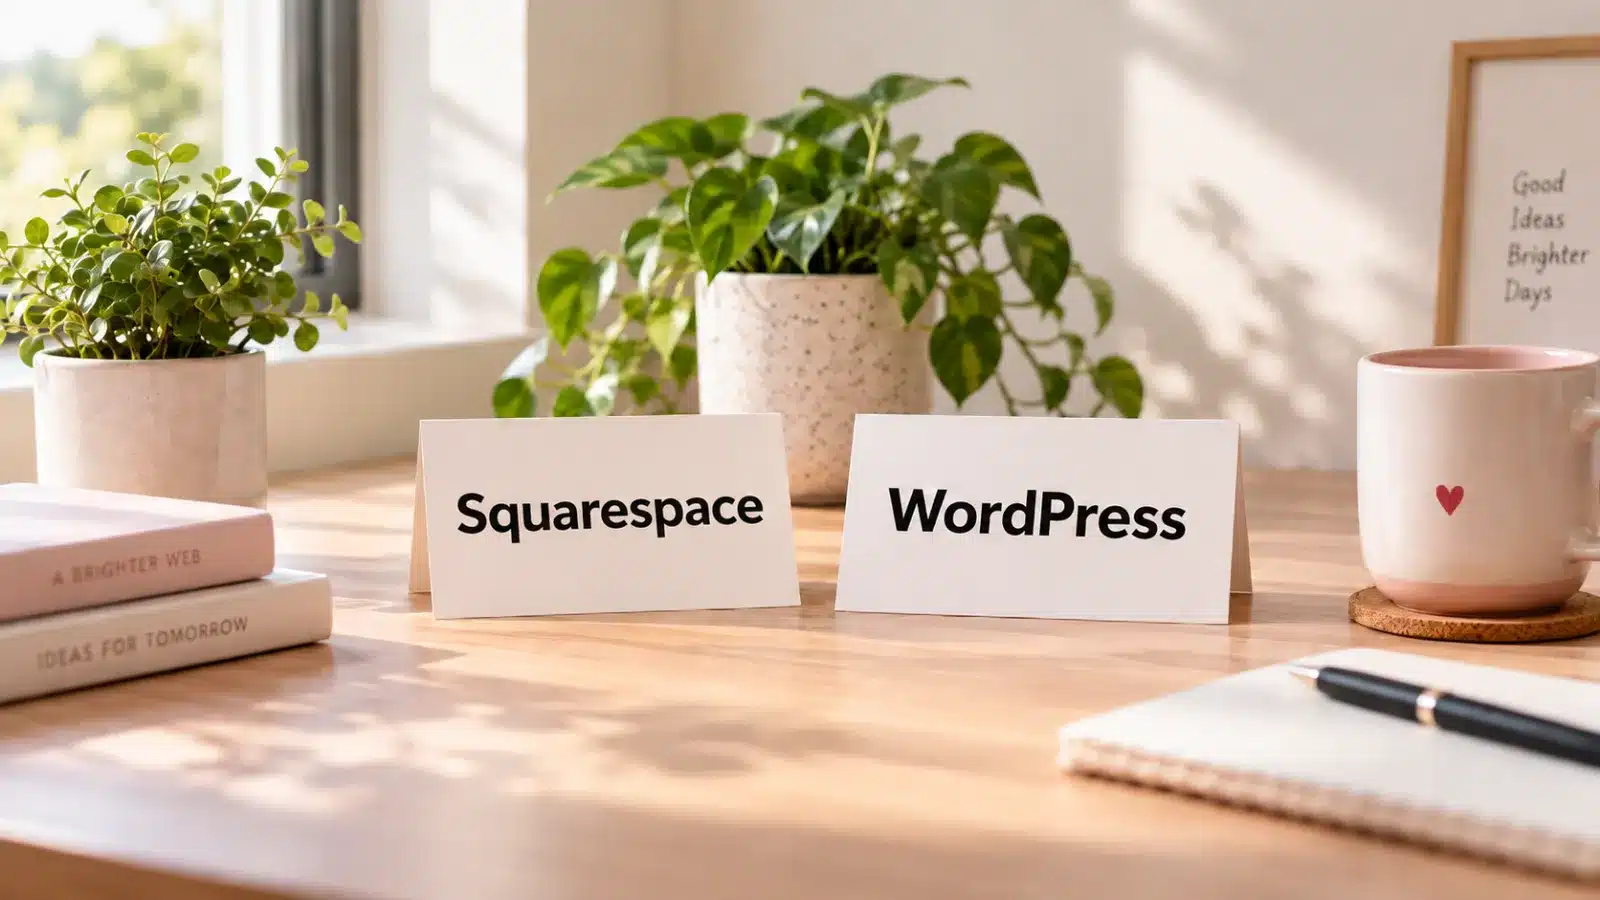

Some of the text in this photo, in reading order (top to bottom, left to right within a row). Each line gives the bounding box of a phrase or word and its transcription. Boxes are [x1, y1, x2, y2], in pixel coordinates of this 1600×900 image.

[1512, 168, 1567, 197] Good
[1510, 206, 1565, 231] Ideas
[1507, 241, 1590, 276] Brighter
[1504, 277, 1552, 311] Days
[457, 492, 764, 543] Squarespace
[888, 487, 1187, 541] WordPress
[52, 548, 202, 586] A BRIGHTER WEB
[37, 616, 249, 670] IDEAS FOR TOMORROW
